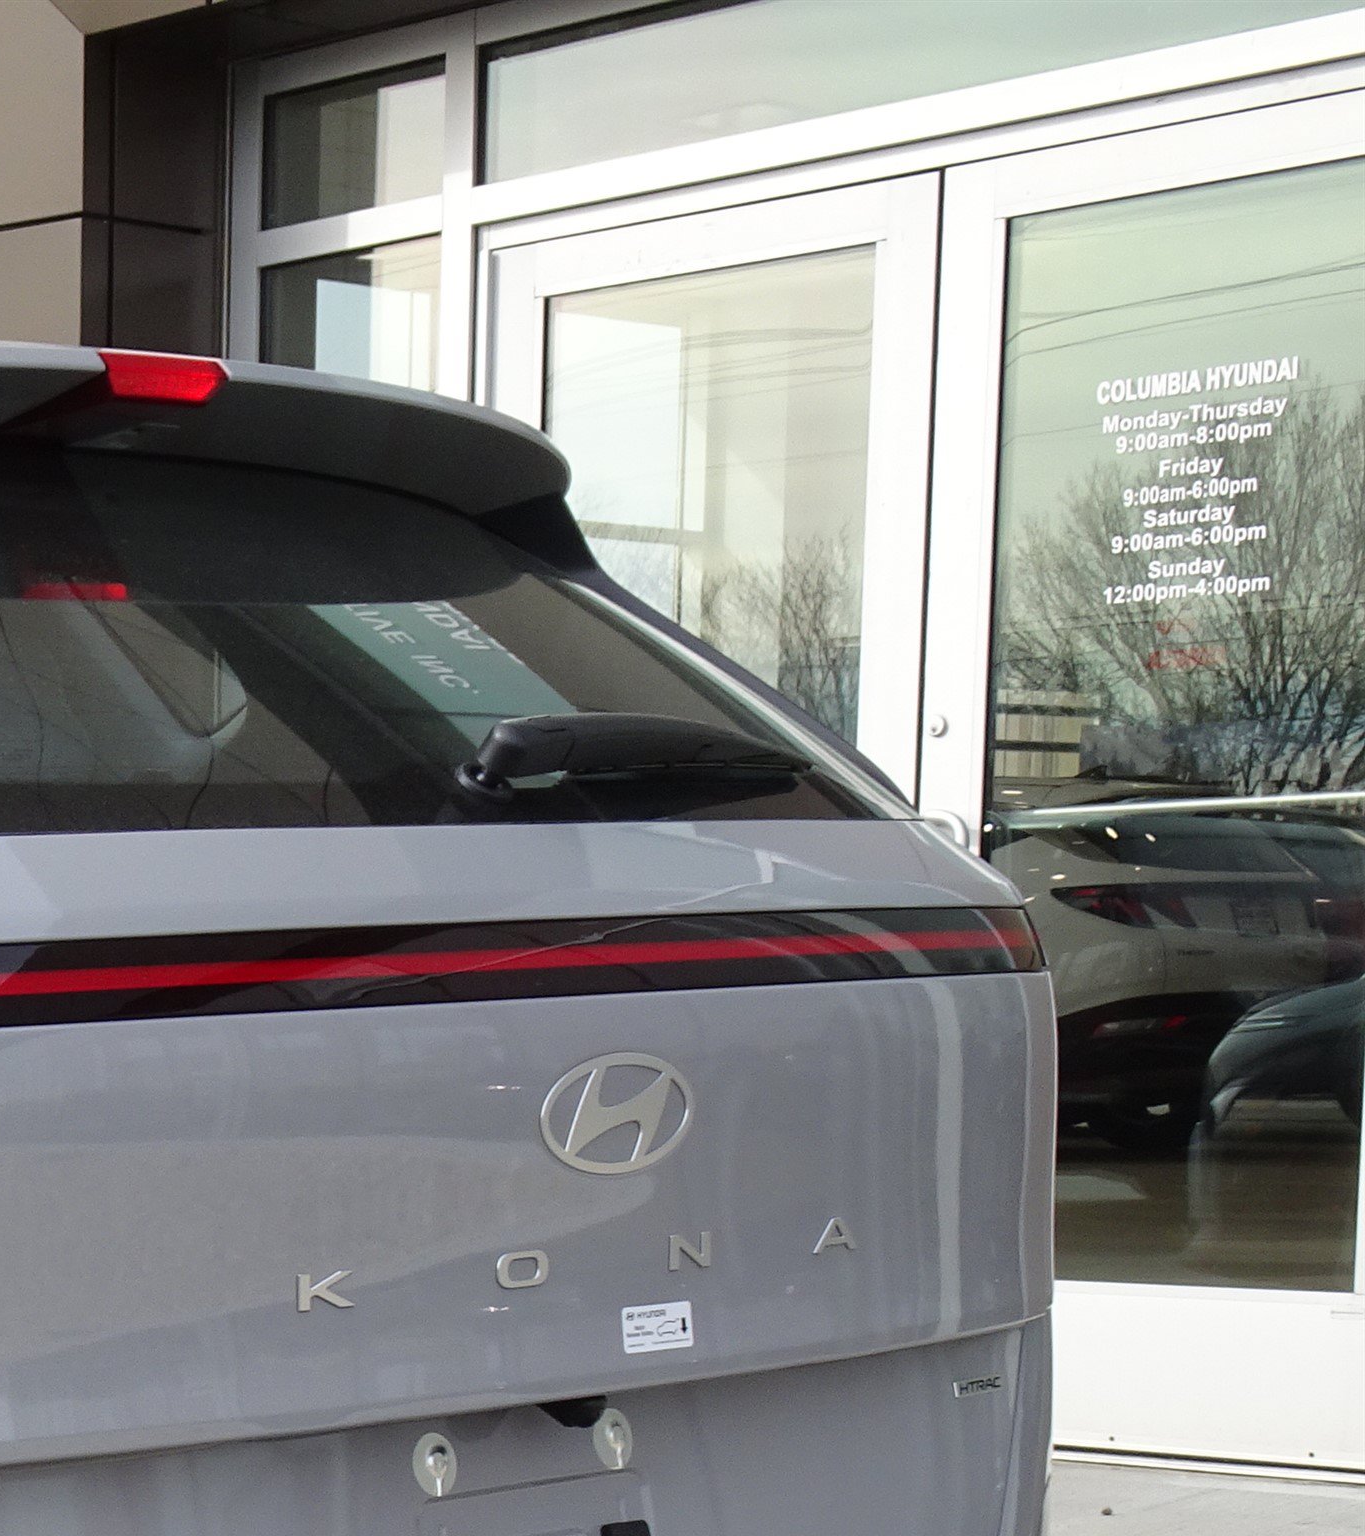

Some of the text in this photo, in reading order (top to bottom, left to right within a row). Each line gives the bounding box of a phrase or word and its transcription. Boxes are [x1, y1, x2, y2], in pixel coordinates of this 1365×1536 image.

[1096, 356, 1299, 405] COLUMBIA HYUNDAI
[1102, 395, 1288, 434] Monday-Thursday
[1115, 421, 1272, 454] 9:00am-8:00pm
[1158, 456, 1224, 478] Friday
[1123, 476, 1258, 507] 9:00am-6:00pm
[1143, 503, 1236, 528] Saturday
[1111, 524, 1268, 554] 9:00am-6:00pm
[1148, 556, 1225, 579] Sunday
[1103, 574, 1271, 605] 12:00pm-4:00pm
[296, 1216, 857, 1312] KONA
[957, 1376, 1001, 1396] HTRAC
